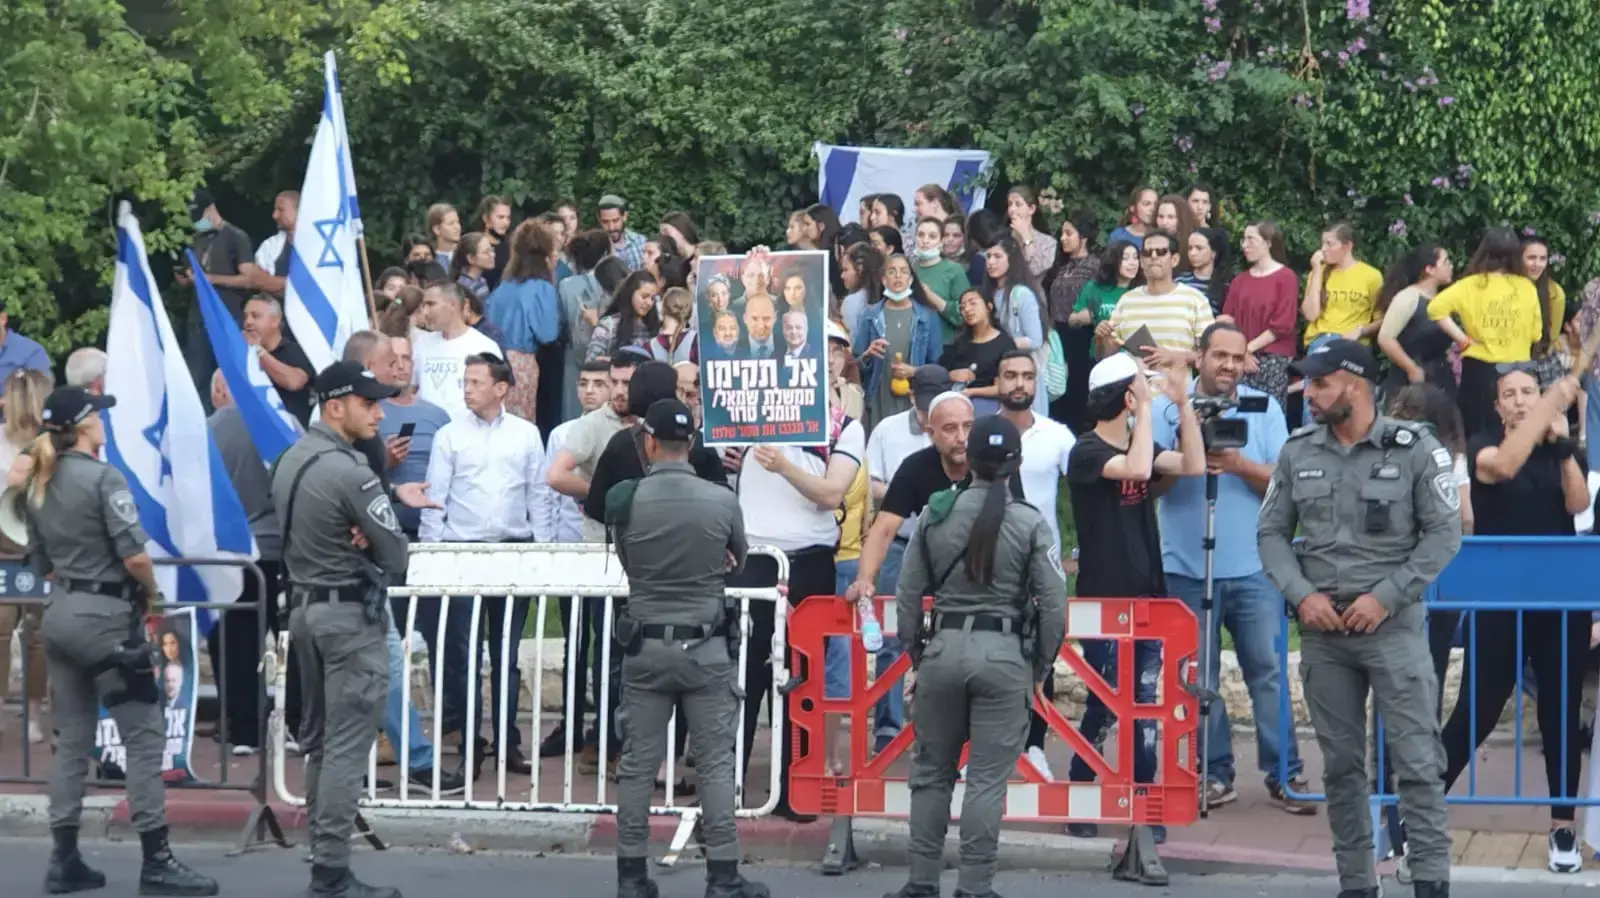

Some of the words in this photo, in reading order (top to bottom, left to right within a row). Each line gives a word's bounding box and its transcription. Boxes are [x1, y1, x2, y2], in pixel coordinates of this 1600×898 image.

[424, 362, 458, 374] GUESS
[707, 359, 778, 390] תקימו
[784, 355, 818, 387] אל
[328, 384, 353, 397] POLICE
[763, 387, 815, 406] ממשלת
[727, 405, 757, 423] טרור
[761, 405, 801, 422] תומכי
[806, 420, 819, 432] אל
